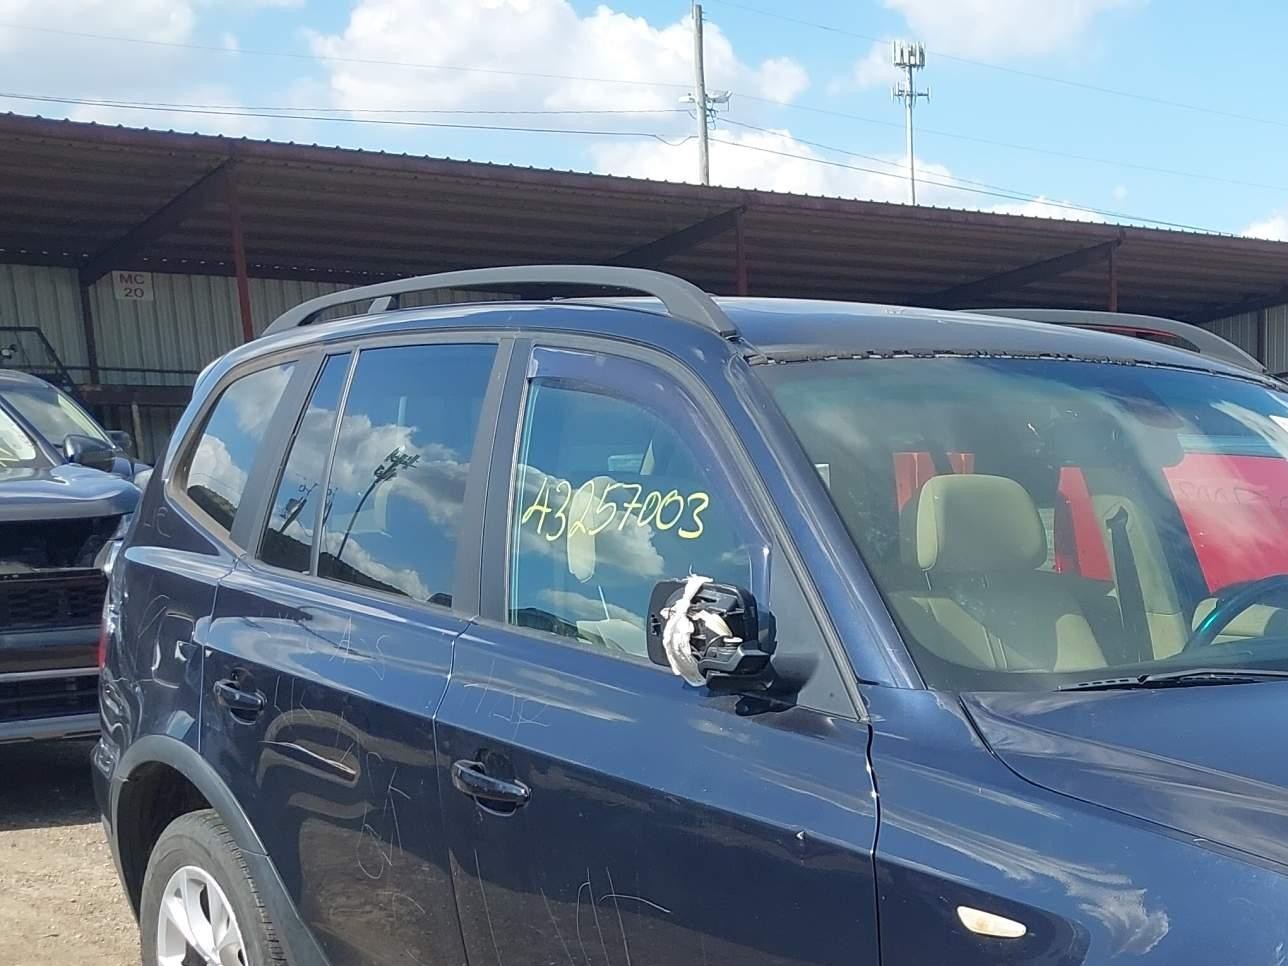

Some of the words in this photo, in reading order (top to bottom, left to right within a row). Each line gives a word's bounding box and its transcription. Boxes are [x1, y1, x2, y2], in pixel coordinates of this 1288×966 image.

[120, 273, 145, 285] MC
[123, 287, 145, 298] 20
[521, 477, 709, 541] 43257003
